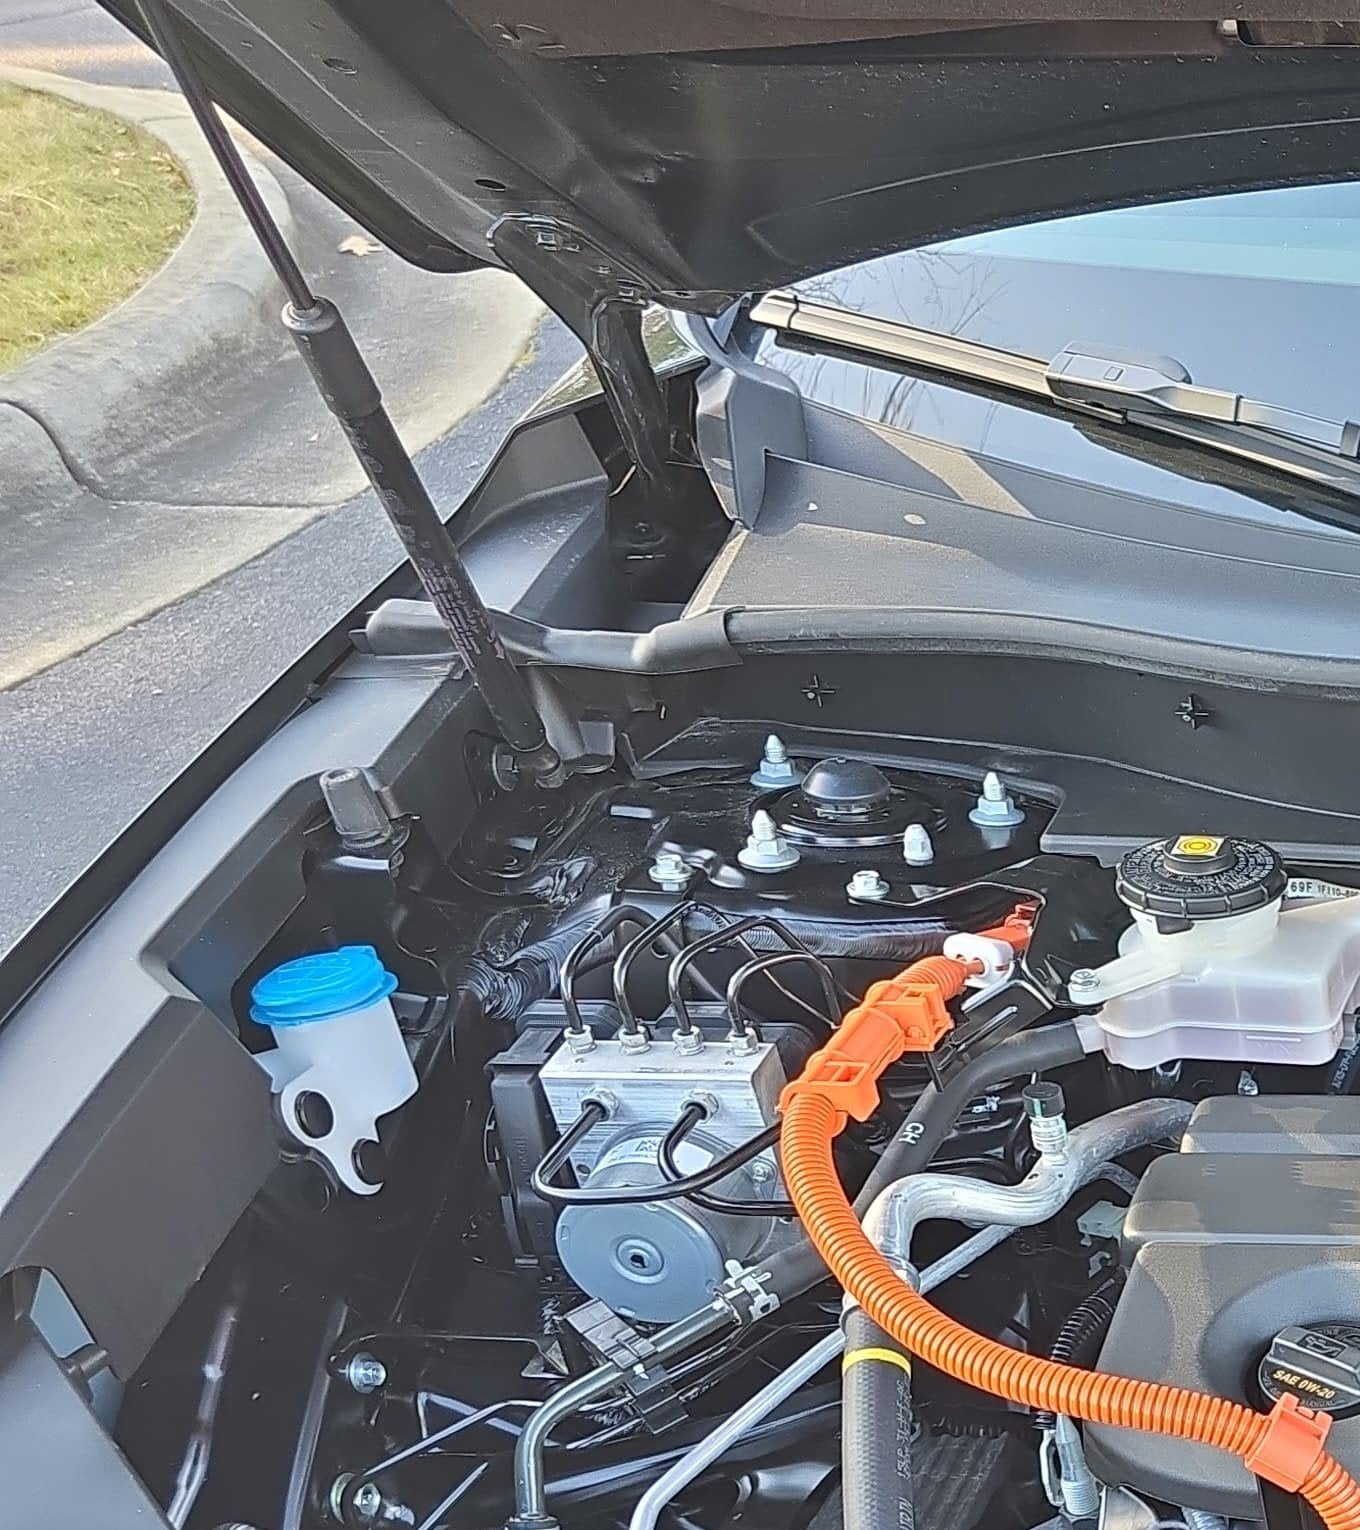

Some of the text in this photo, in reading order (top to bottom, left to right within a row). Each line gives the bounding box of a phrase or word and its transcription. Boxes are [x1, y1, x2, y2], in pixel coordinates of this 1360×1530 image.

[1290, 881, 1313, 893] 69F
[898, 1122, 925, 1145] CH
[1272, 1369, 1299, 1387] SAE
[1299, 1379, 1337, 1400] 0W-20
